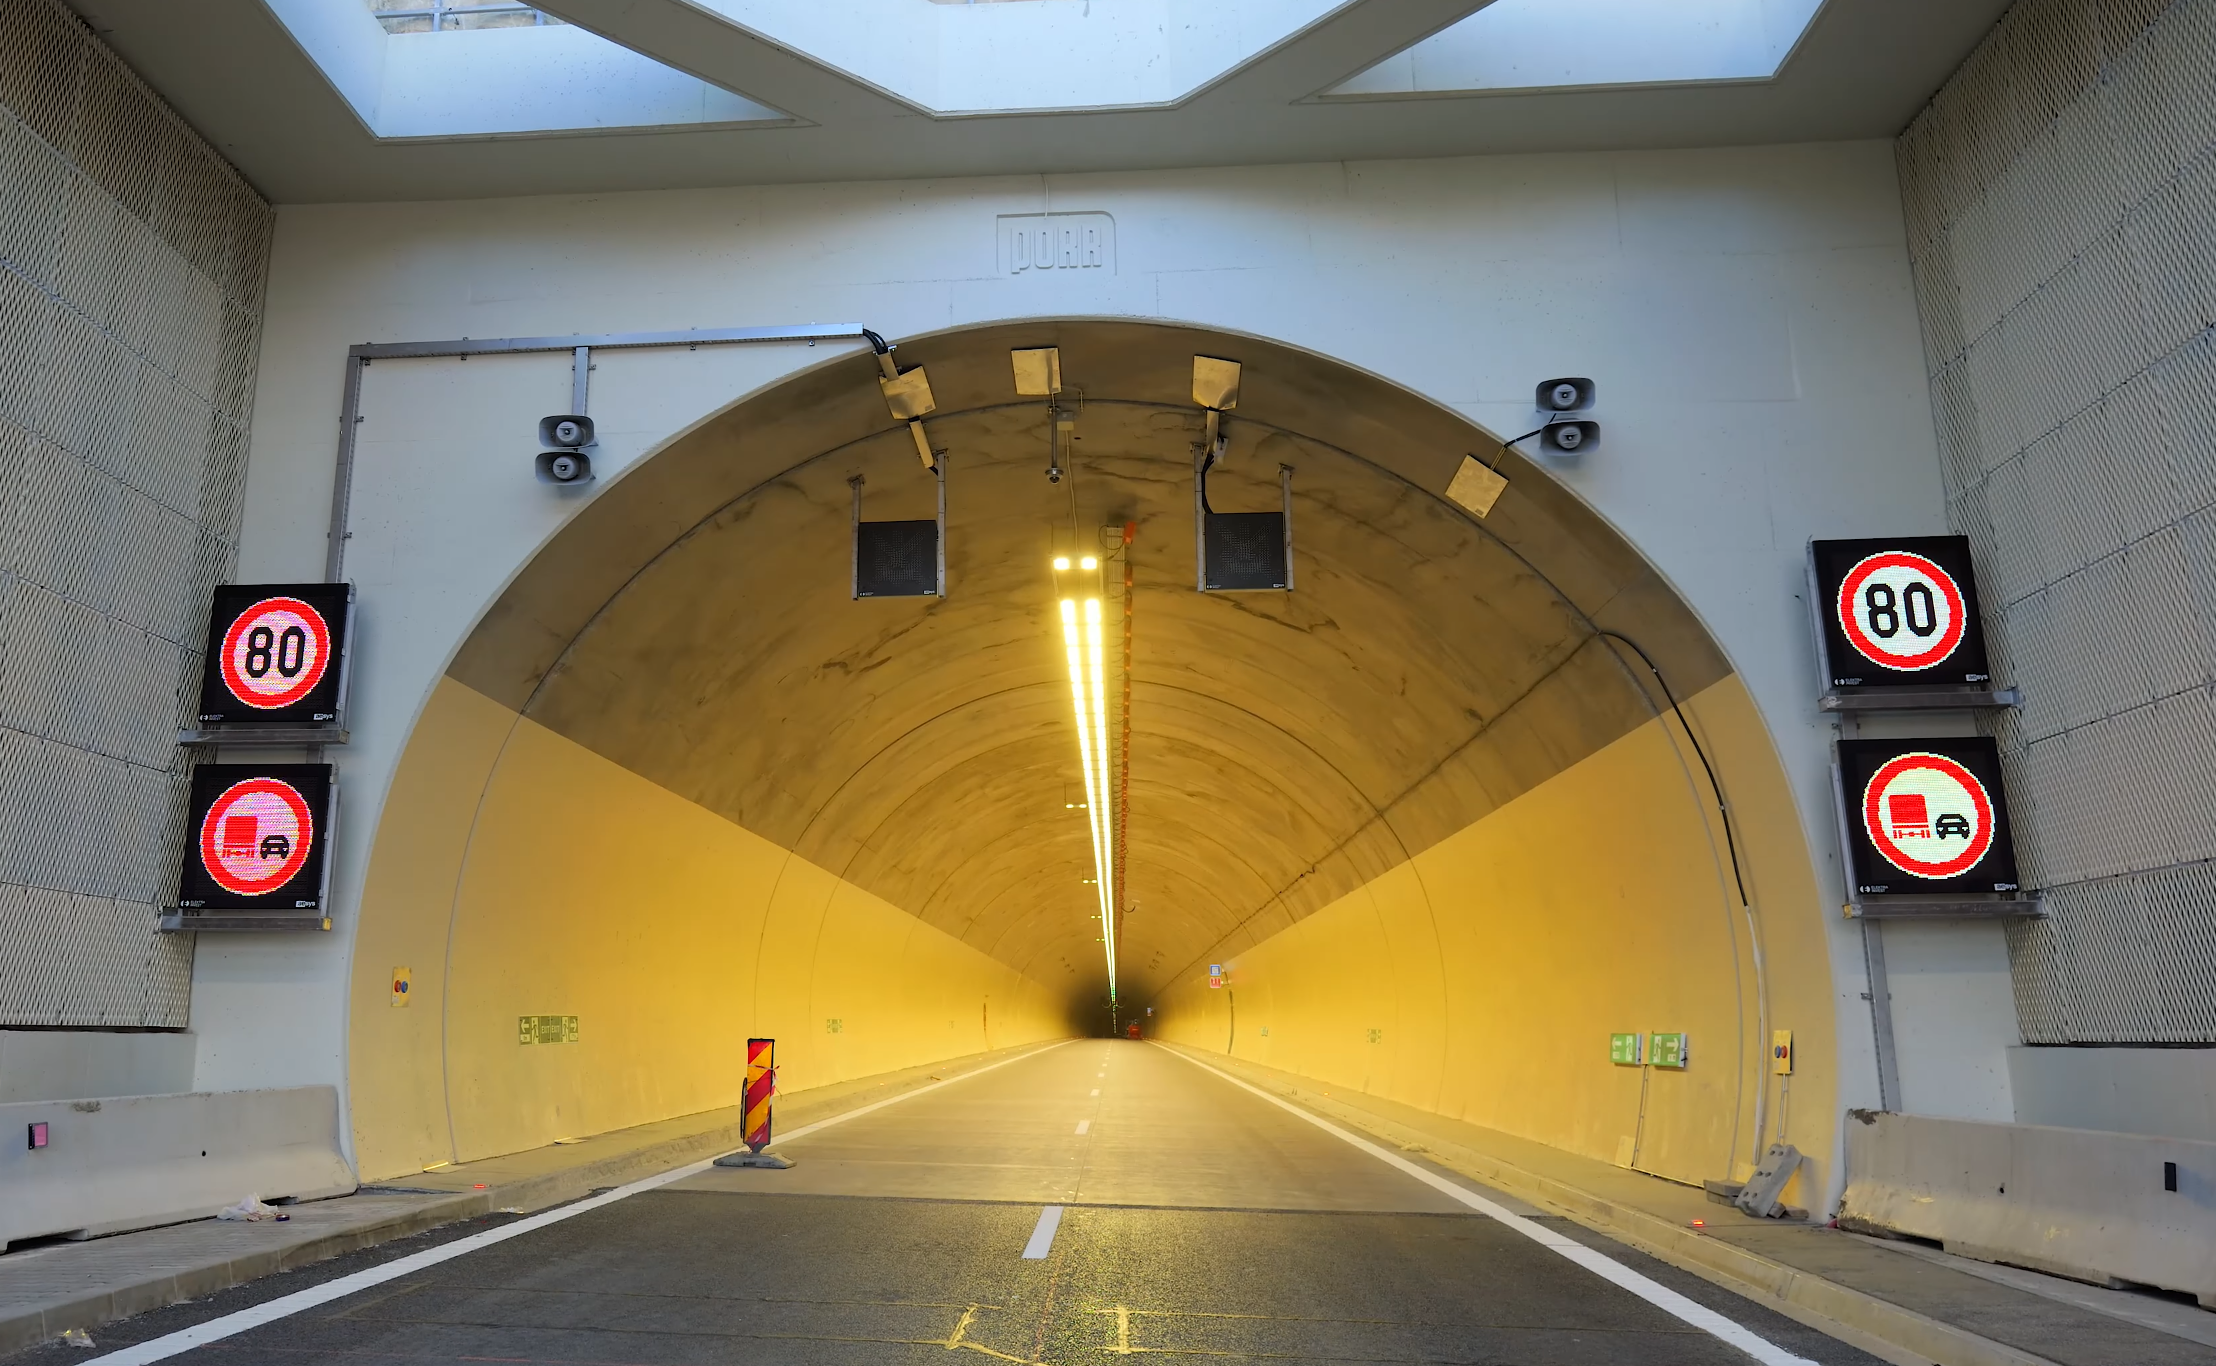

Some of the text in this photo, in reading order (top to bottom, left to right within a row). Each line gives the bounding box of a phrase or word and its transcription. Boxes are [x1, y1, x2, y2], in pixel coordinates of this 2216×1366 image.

[1866, 582, 1937, 638] 80
[245, 626, 306, 678] 80
[541, 1025, 550, 1034] EXIT
[551, 1024, 560, 1033] EXIT
